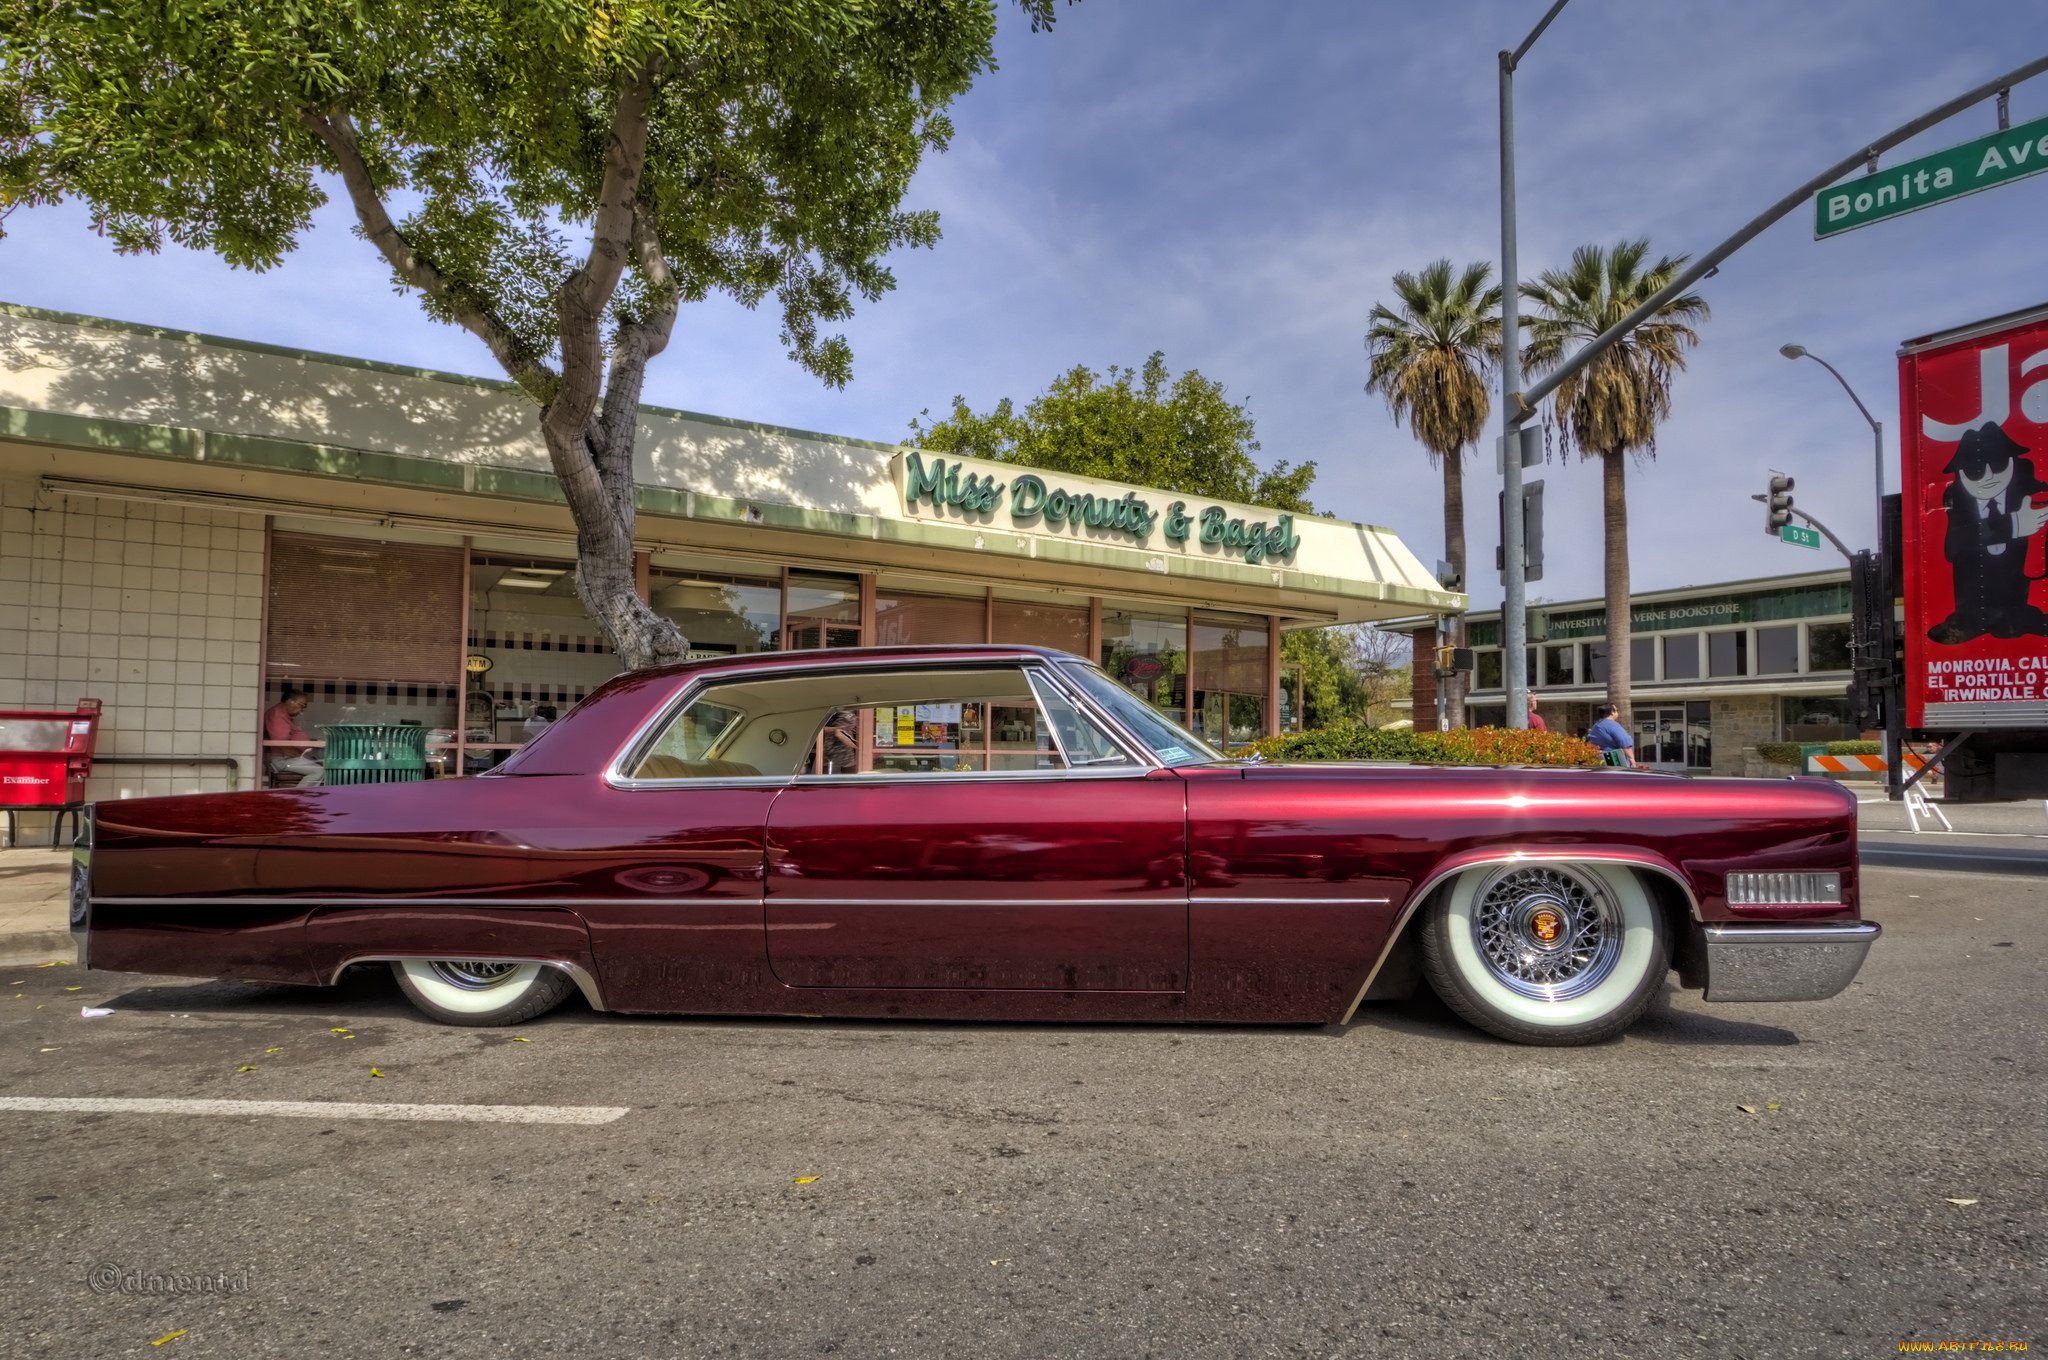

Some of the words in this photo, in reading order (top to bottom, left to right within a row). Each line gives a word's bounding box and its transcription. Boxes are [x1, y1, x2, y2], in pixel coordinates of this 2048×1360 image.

[1828, 166, 1954, 222] Bonita
[906, 451, 1005, 513] Miss
[1010, 473, 1159, 538] Donuts
[1164, 500, 1195, 543] &
[1199, 504, 1301, 564] Bagel
[1793, 530, 1799, 540] D
[1801, 532, 1810, 543] St
[1633, 610, 1667, 623] VERNE
[1669, 603, 1740, 619] BOOKSTORE
[467, 659, 486, 668] ATM
[1928, 659, 2015, 674] MONROVIA.
[1928, 676, 1948, 689] EL
[1955, 672, 2037, 687] PORTILLO
[1944, 686, 2040, 701] IRWINDALE.
[3, 776, 50, 785] Examiner
